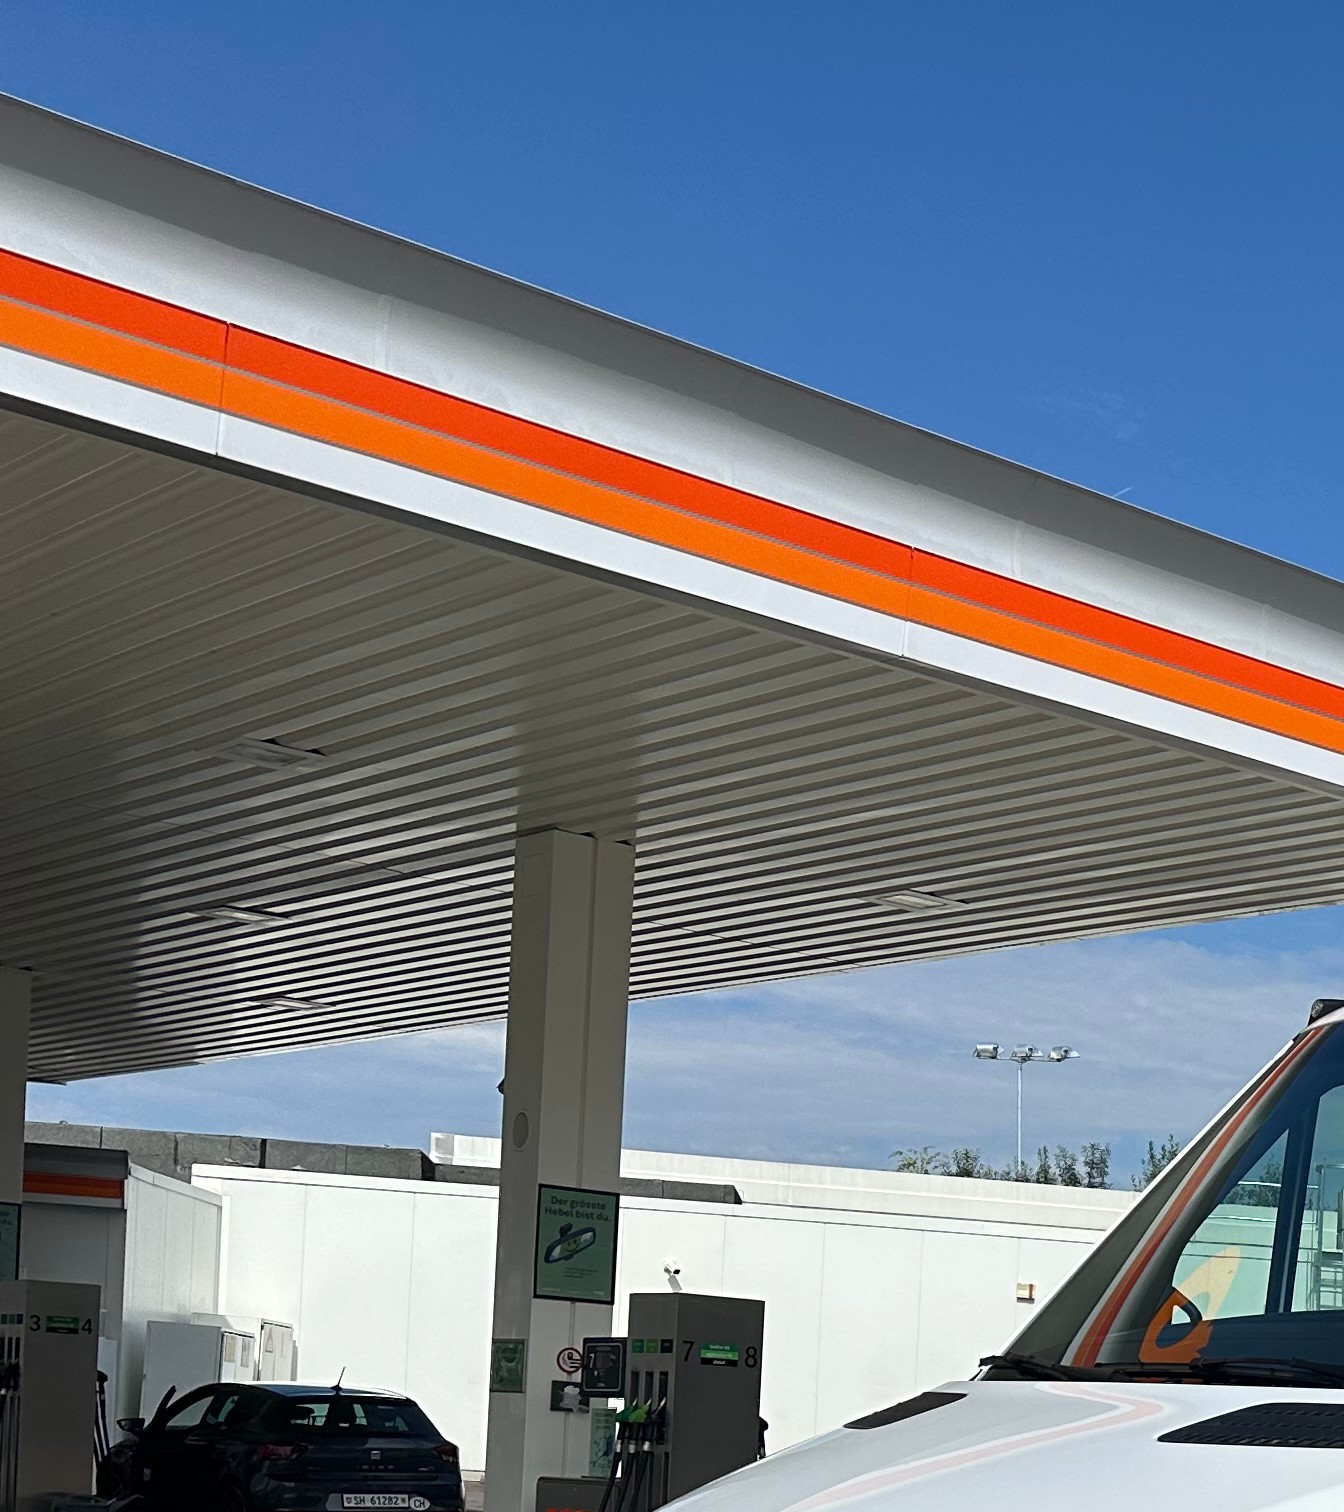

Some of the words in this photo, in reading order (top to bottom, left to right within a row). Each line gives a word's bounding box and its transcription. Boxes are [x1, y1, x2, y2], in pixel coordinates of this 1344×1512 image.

[551, 1195, 568, 1206] Der
[570, 1199, 607, 1211] grösste
[544, 1206, 574, 1218] Hebel
[576, 1209, 595, 1220] bist
[29, 1314, 41, 1332] 3
[81, 1317, 93, 1335] 4
[682, 1340, 695, 1363] 7
[744, 1345, 758, 1369] 8
[413, 1498, 426, 1509] CH
